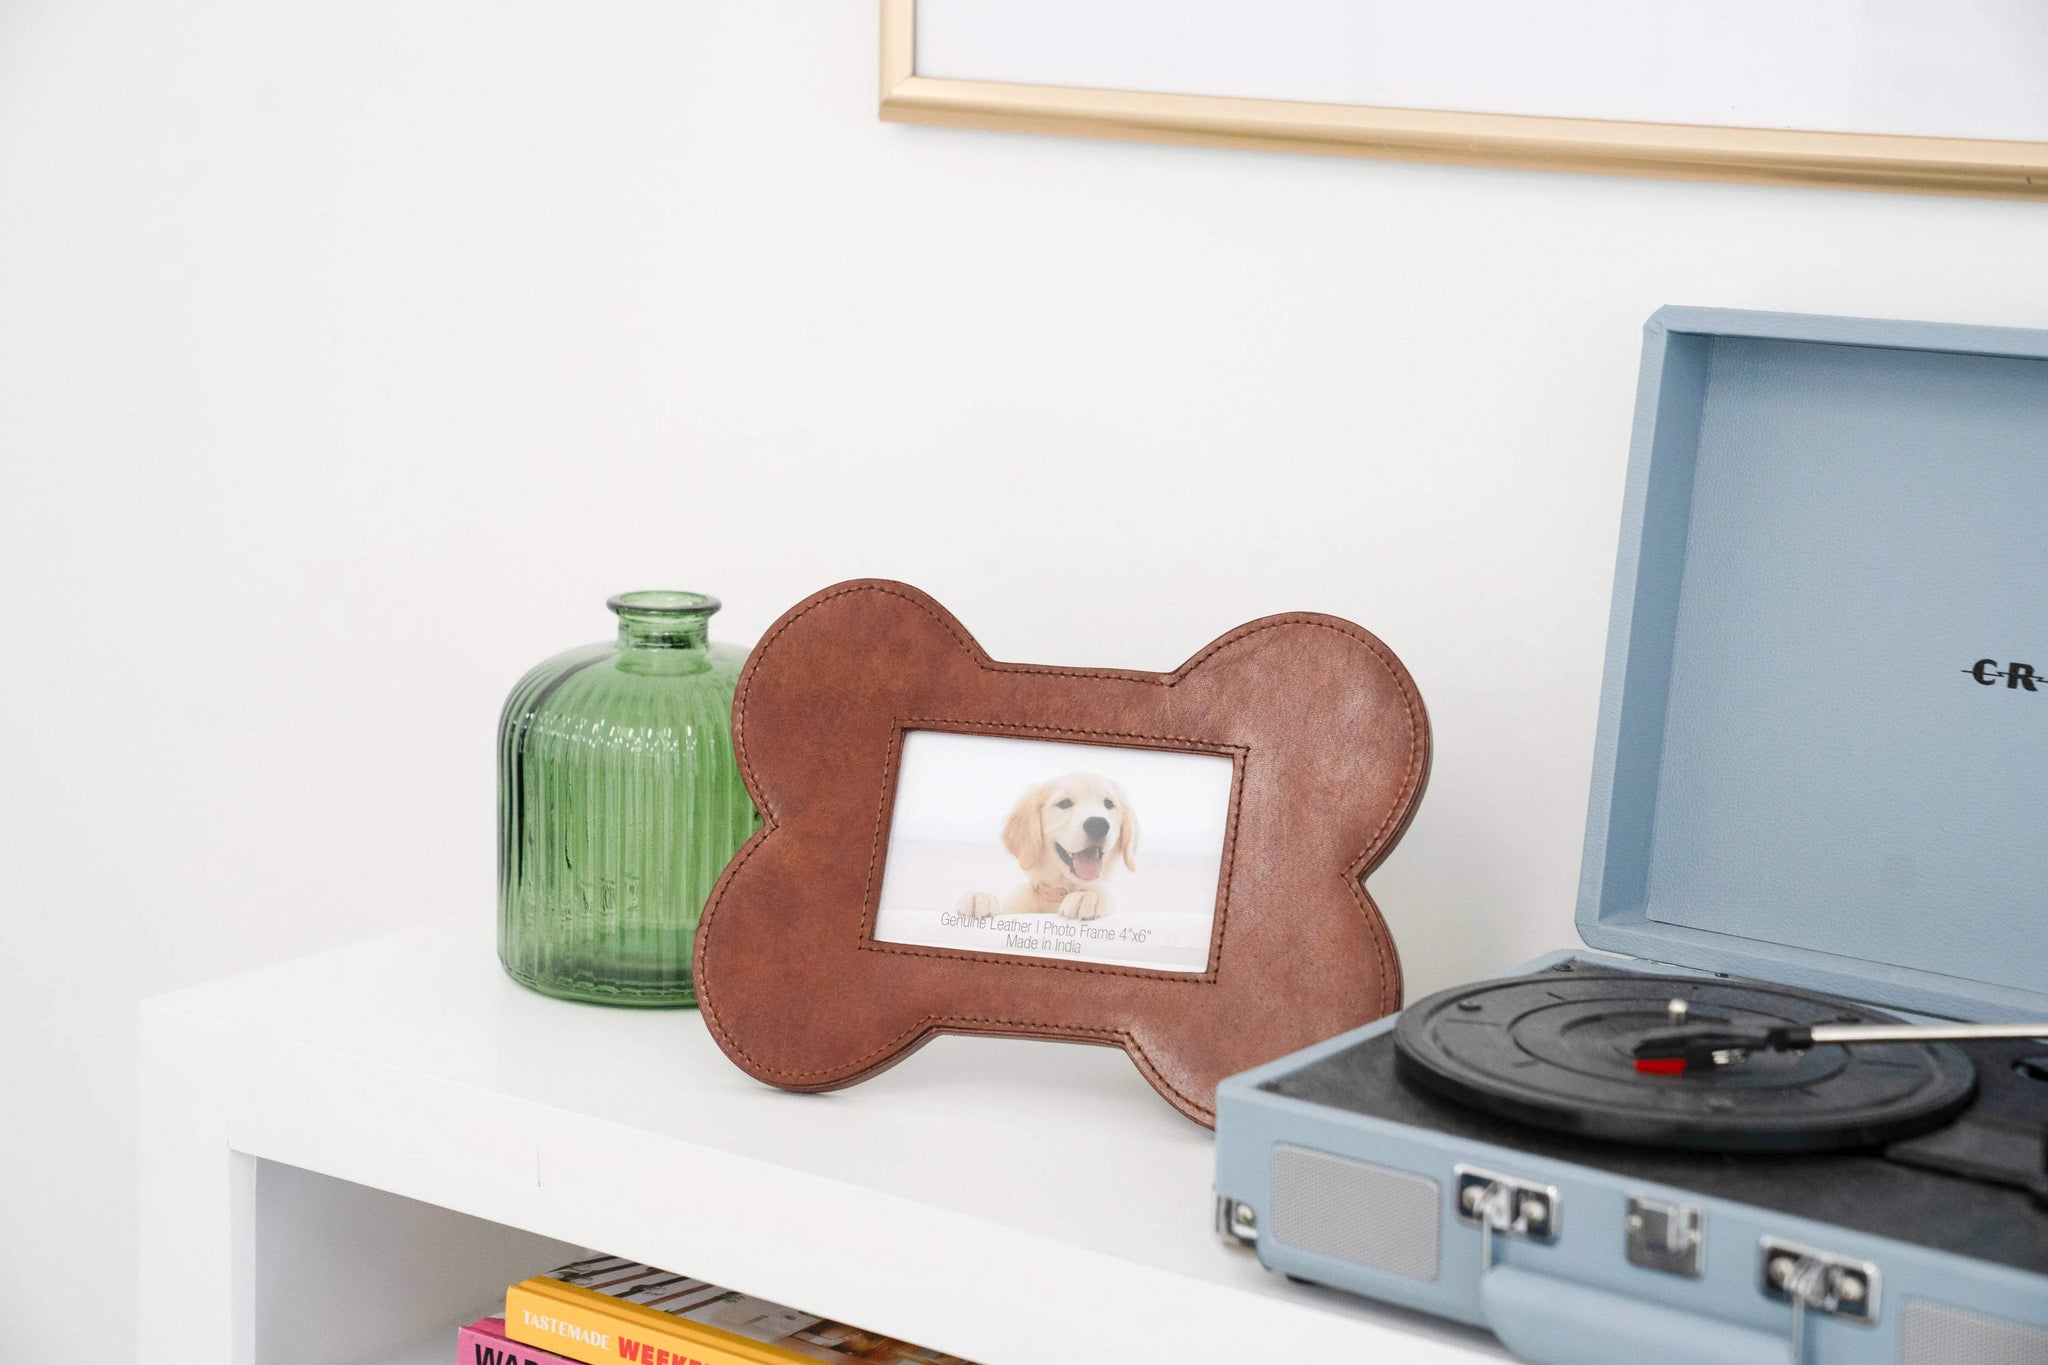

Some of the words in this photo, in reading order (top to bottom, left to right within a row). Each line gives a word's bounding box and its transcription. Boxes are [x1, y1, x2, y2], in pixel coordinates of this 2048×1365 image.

[940, 911, 987, 929] Genuine
[990, 916, 1032, 933] Leather
[1043, 920, 1076, 938] Photo
[1080, 924, 1116, 940] Frame
[1006, 934, 1038, 949] Made
[1041, 936, 1052, 951] in
[1055, 937, 1081, 954] India
[522, 1310, 611, 1350] TASTEMADE
